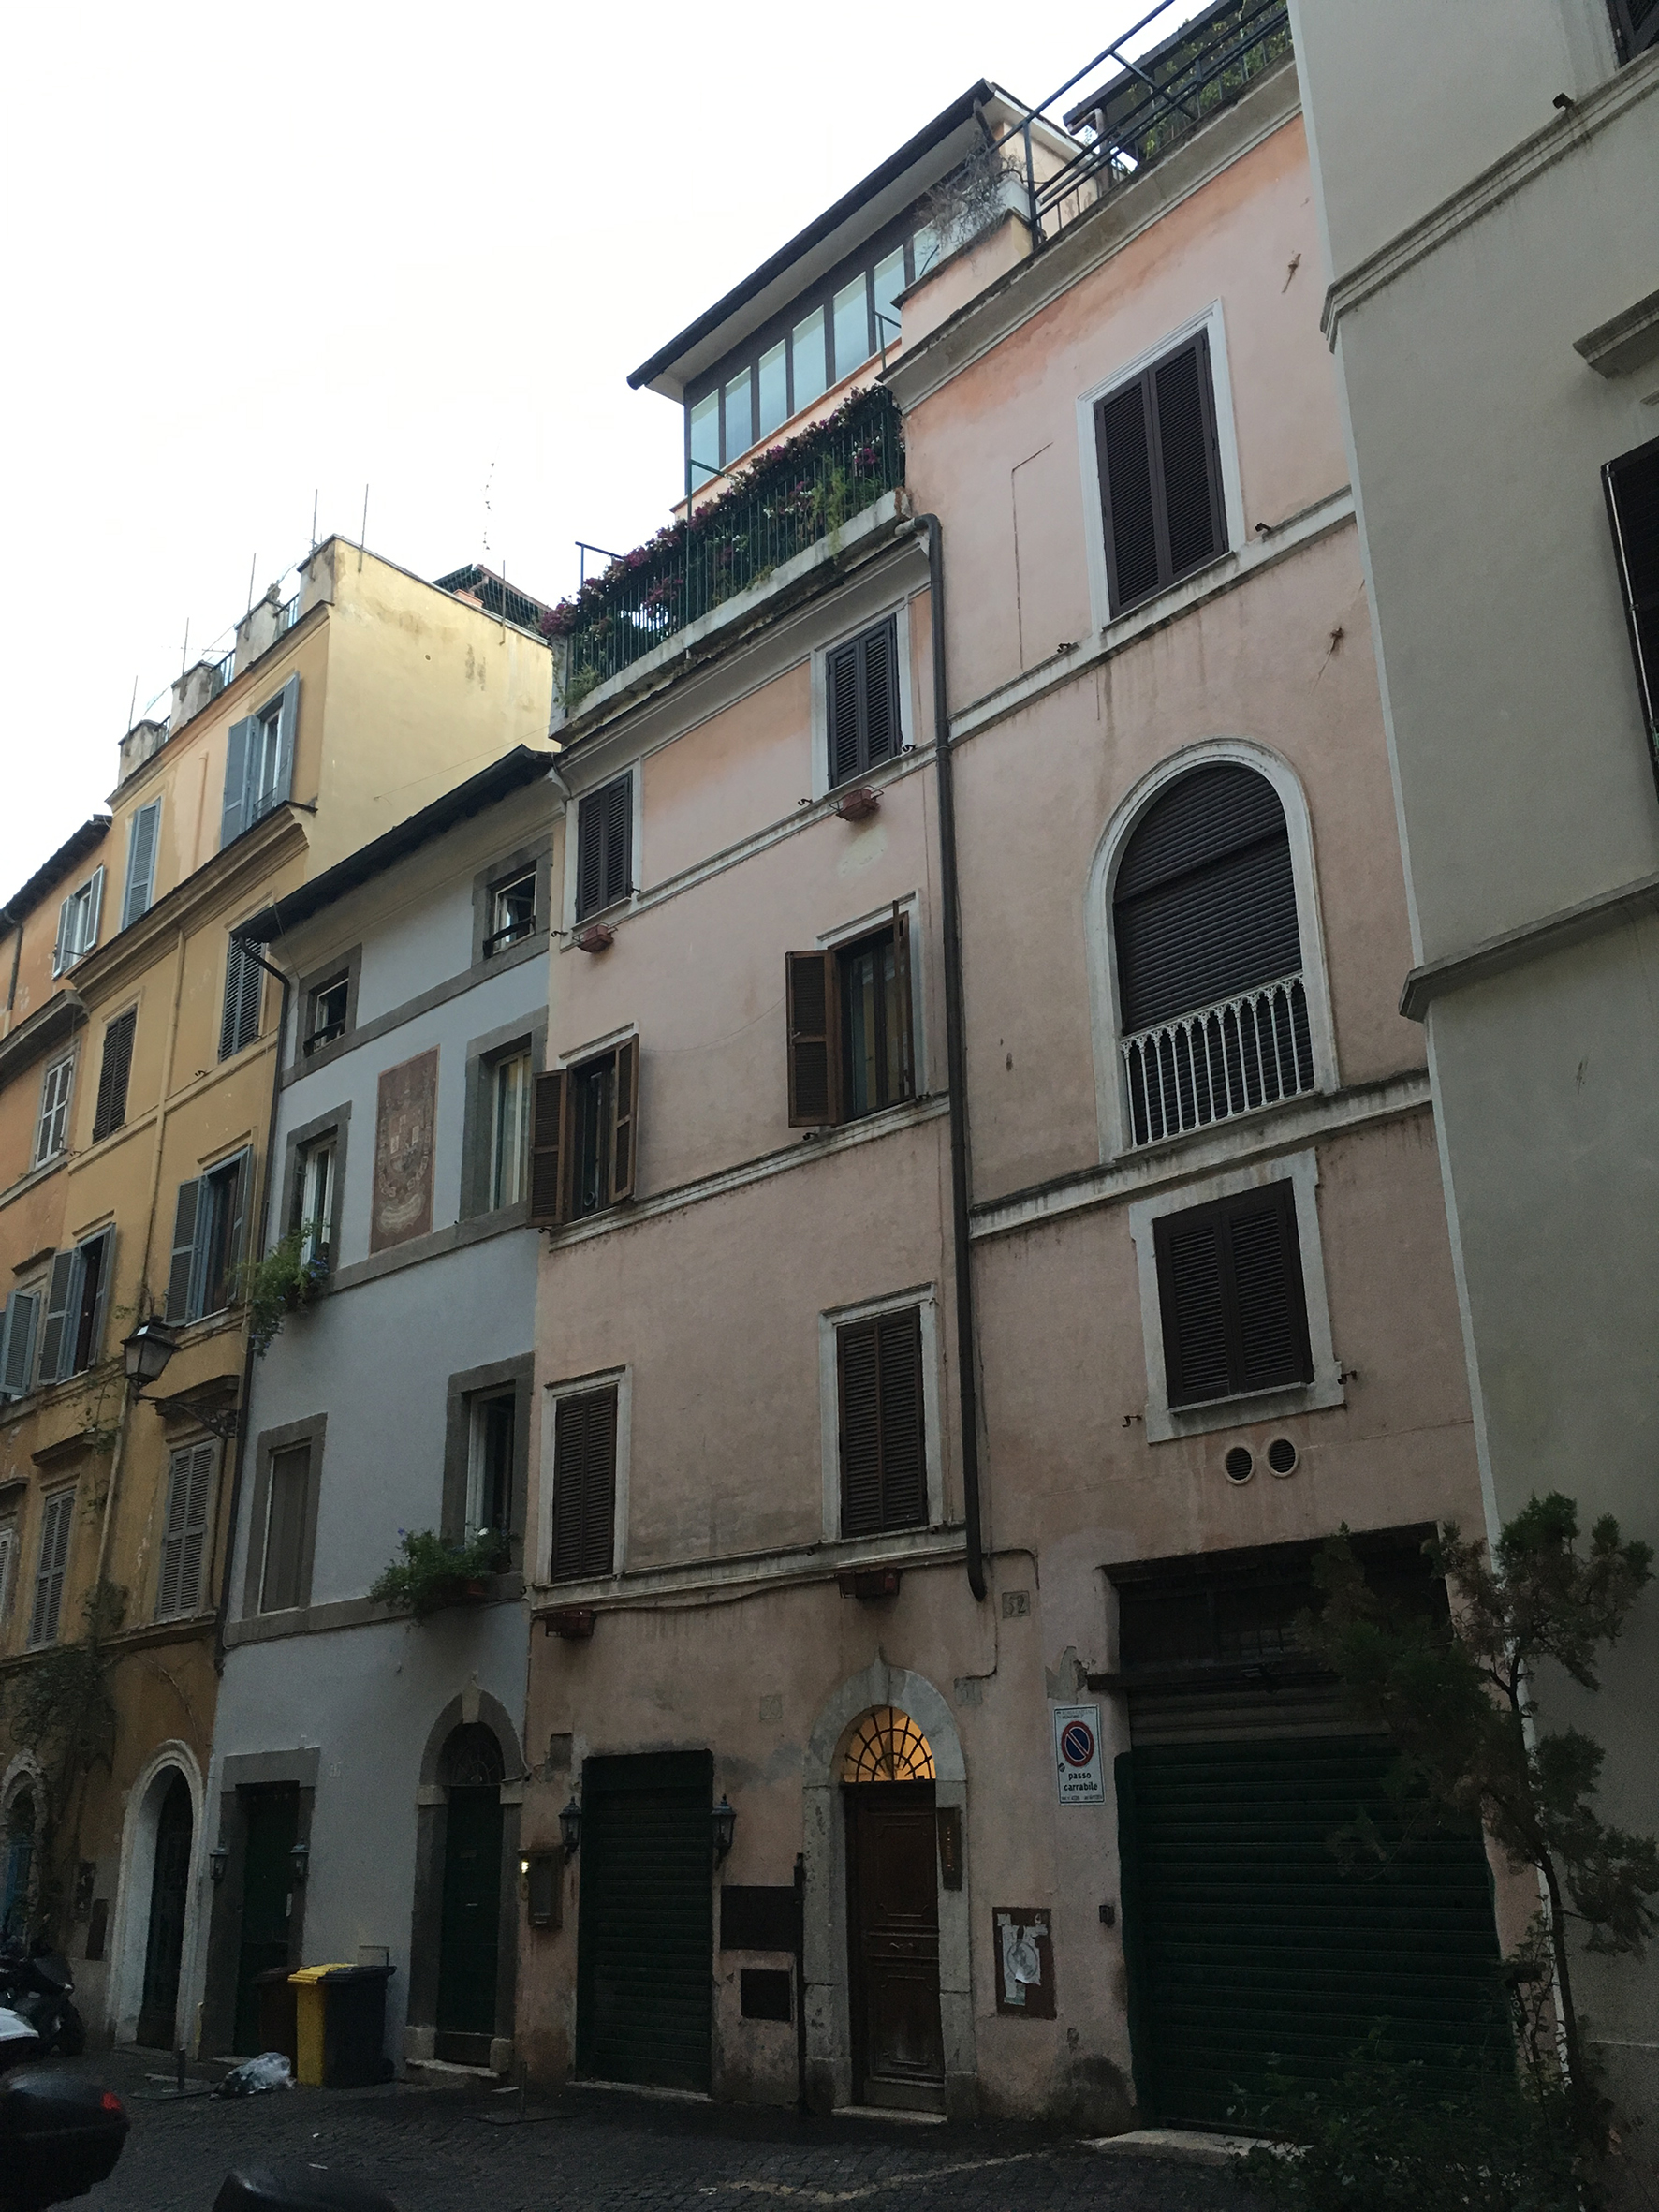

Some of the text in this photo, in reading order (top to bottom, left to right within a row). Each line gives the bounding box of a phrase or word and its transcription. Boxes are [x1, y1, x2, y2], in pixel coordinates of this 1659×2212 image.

[1006, 1595, 1026, 1615] 52
[1068, 1772, 1092, 1782] passo
[1064, 1781, 1098, 1791] carrabile
